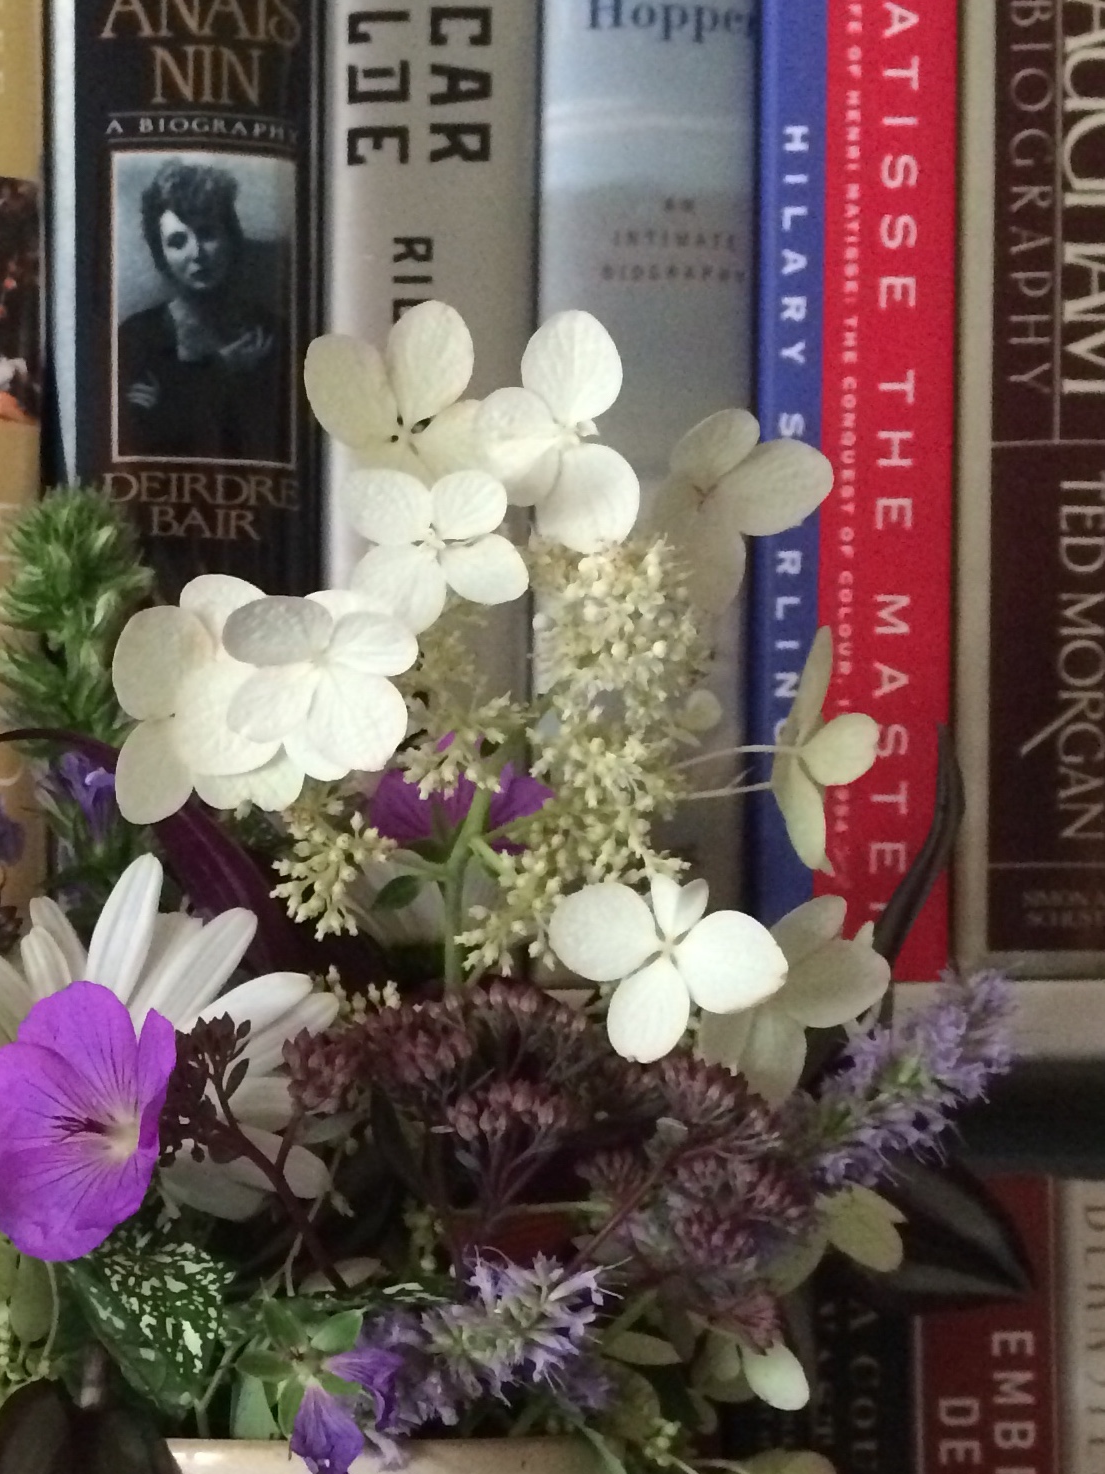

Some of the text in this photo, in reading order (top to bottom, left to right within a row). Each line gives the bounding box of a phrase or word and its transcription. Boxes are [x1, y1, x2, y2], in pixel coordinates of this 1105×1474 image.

[150, 46, 263, 107] NIN
[429, 6, 493, 163] CAR
[846, 45, 862, 78] OF
[105, 117, 300, 146] A BIOGRAPHY
[845, 90, 862, 171] HENRI
[1009, 1, 1054, 395] BIOGRAPHY
[842, 316, 859, 364] THE
[774, 124, 810, 738] HILARY SRLIN
[838, 376, 858, 514] CONQUEST
[868, 1, 921, 912] ATISSE THE MASTE
[101, 471, 301, 511] DEIRDRE
[150, 505, 262, 541] BAIR
[1058, 472, 1105, 574] TED
[839, 527, 855, 559] OF
[1021, 592, 1105, 841] MORGAN
